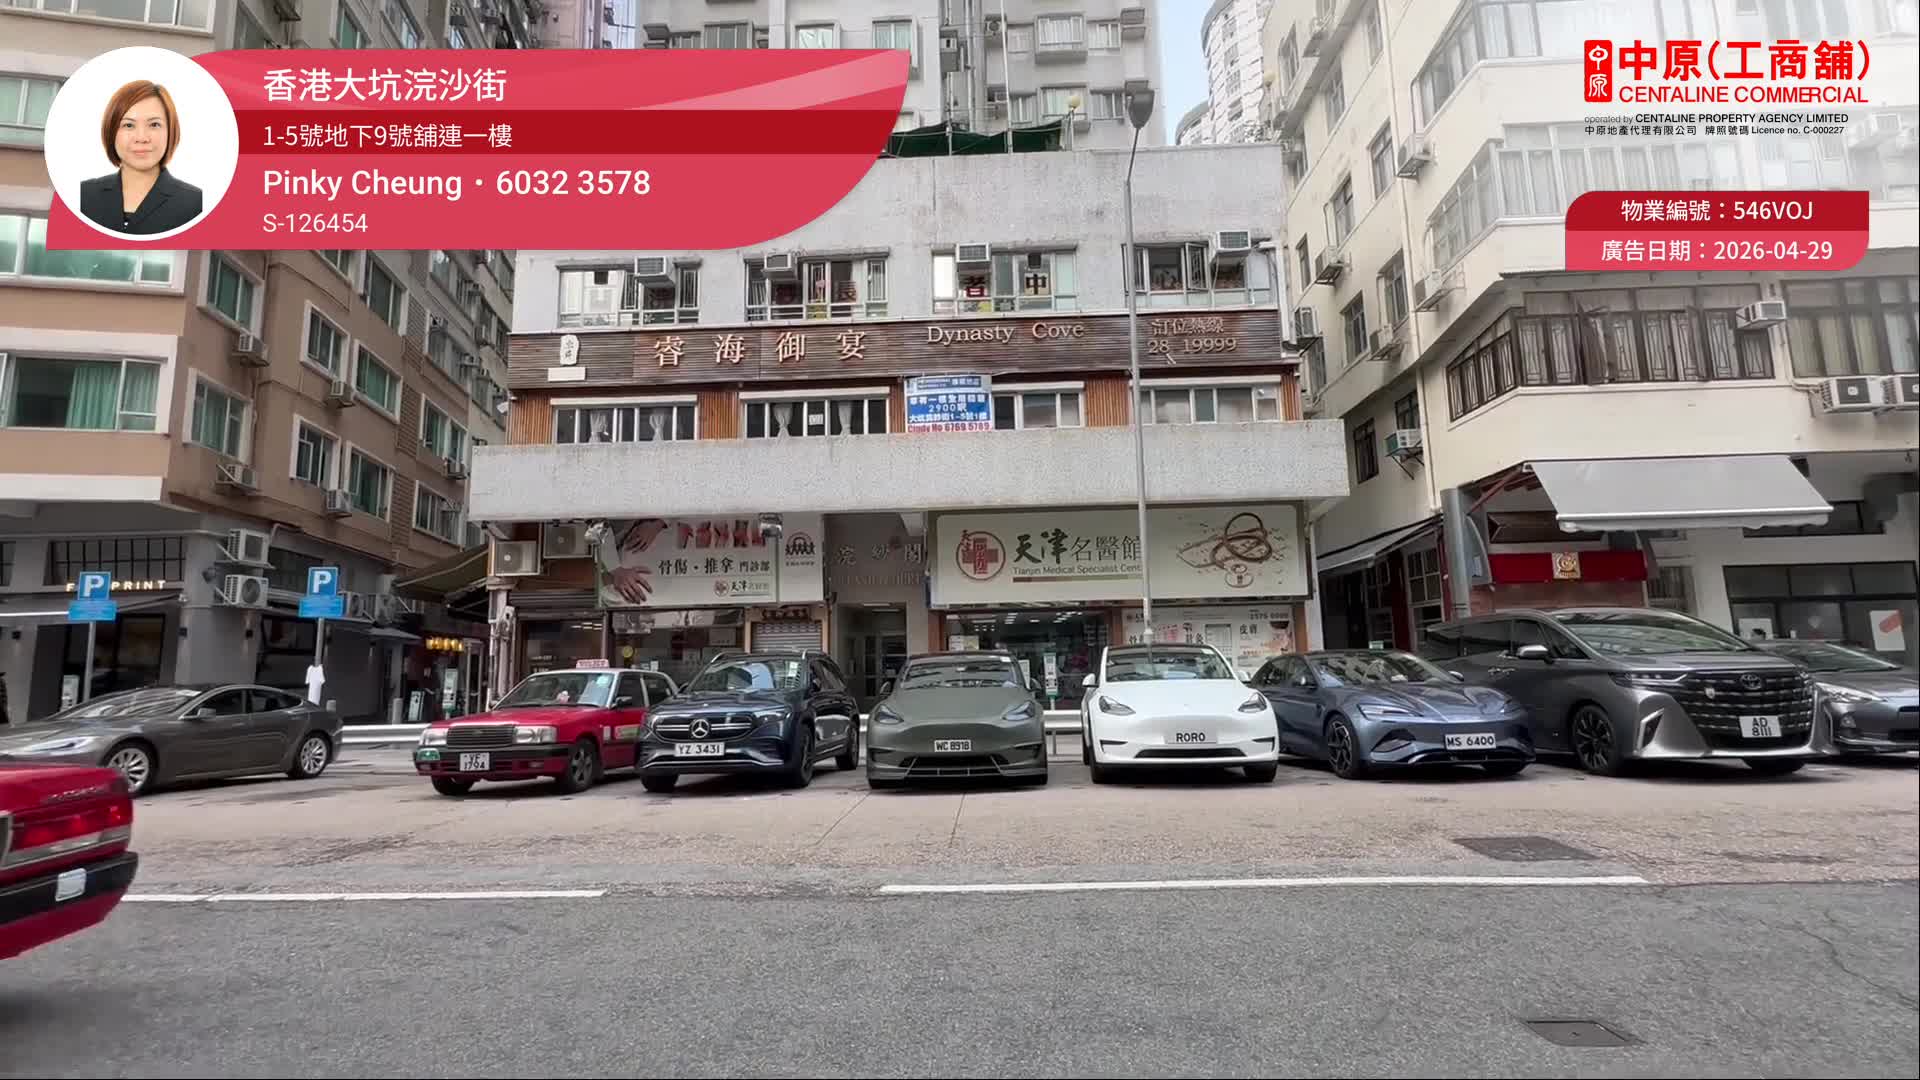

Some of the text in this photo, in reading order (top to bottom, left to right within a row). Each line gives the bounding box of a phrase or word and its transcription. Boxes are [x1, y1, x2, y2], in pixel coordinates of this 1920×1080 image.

[1025, 273, 1047, 295] 中
[927, 321, 1085, 347] Dynasty Cove
[654, 328, 867, 368] 睿海御宴
[1014, 528, 1142, 564] 天津名醫館
[1042, 564, 1075, 575] Medical
[83, 575, 104, 597] P
[313, 571, 331, 593] P
[1752, 717, 1768, 728] AD
[1175, 732, 1206, 742] RORO
[1447, 735, 1494, 747] MS 6400
[679, 743, 720, 755] YZ 3431
[935, 741, 949, 751] WC
